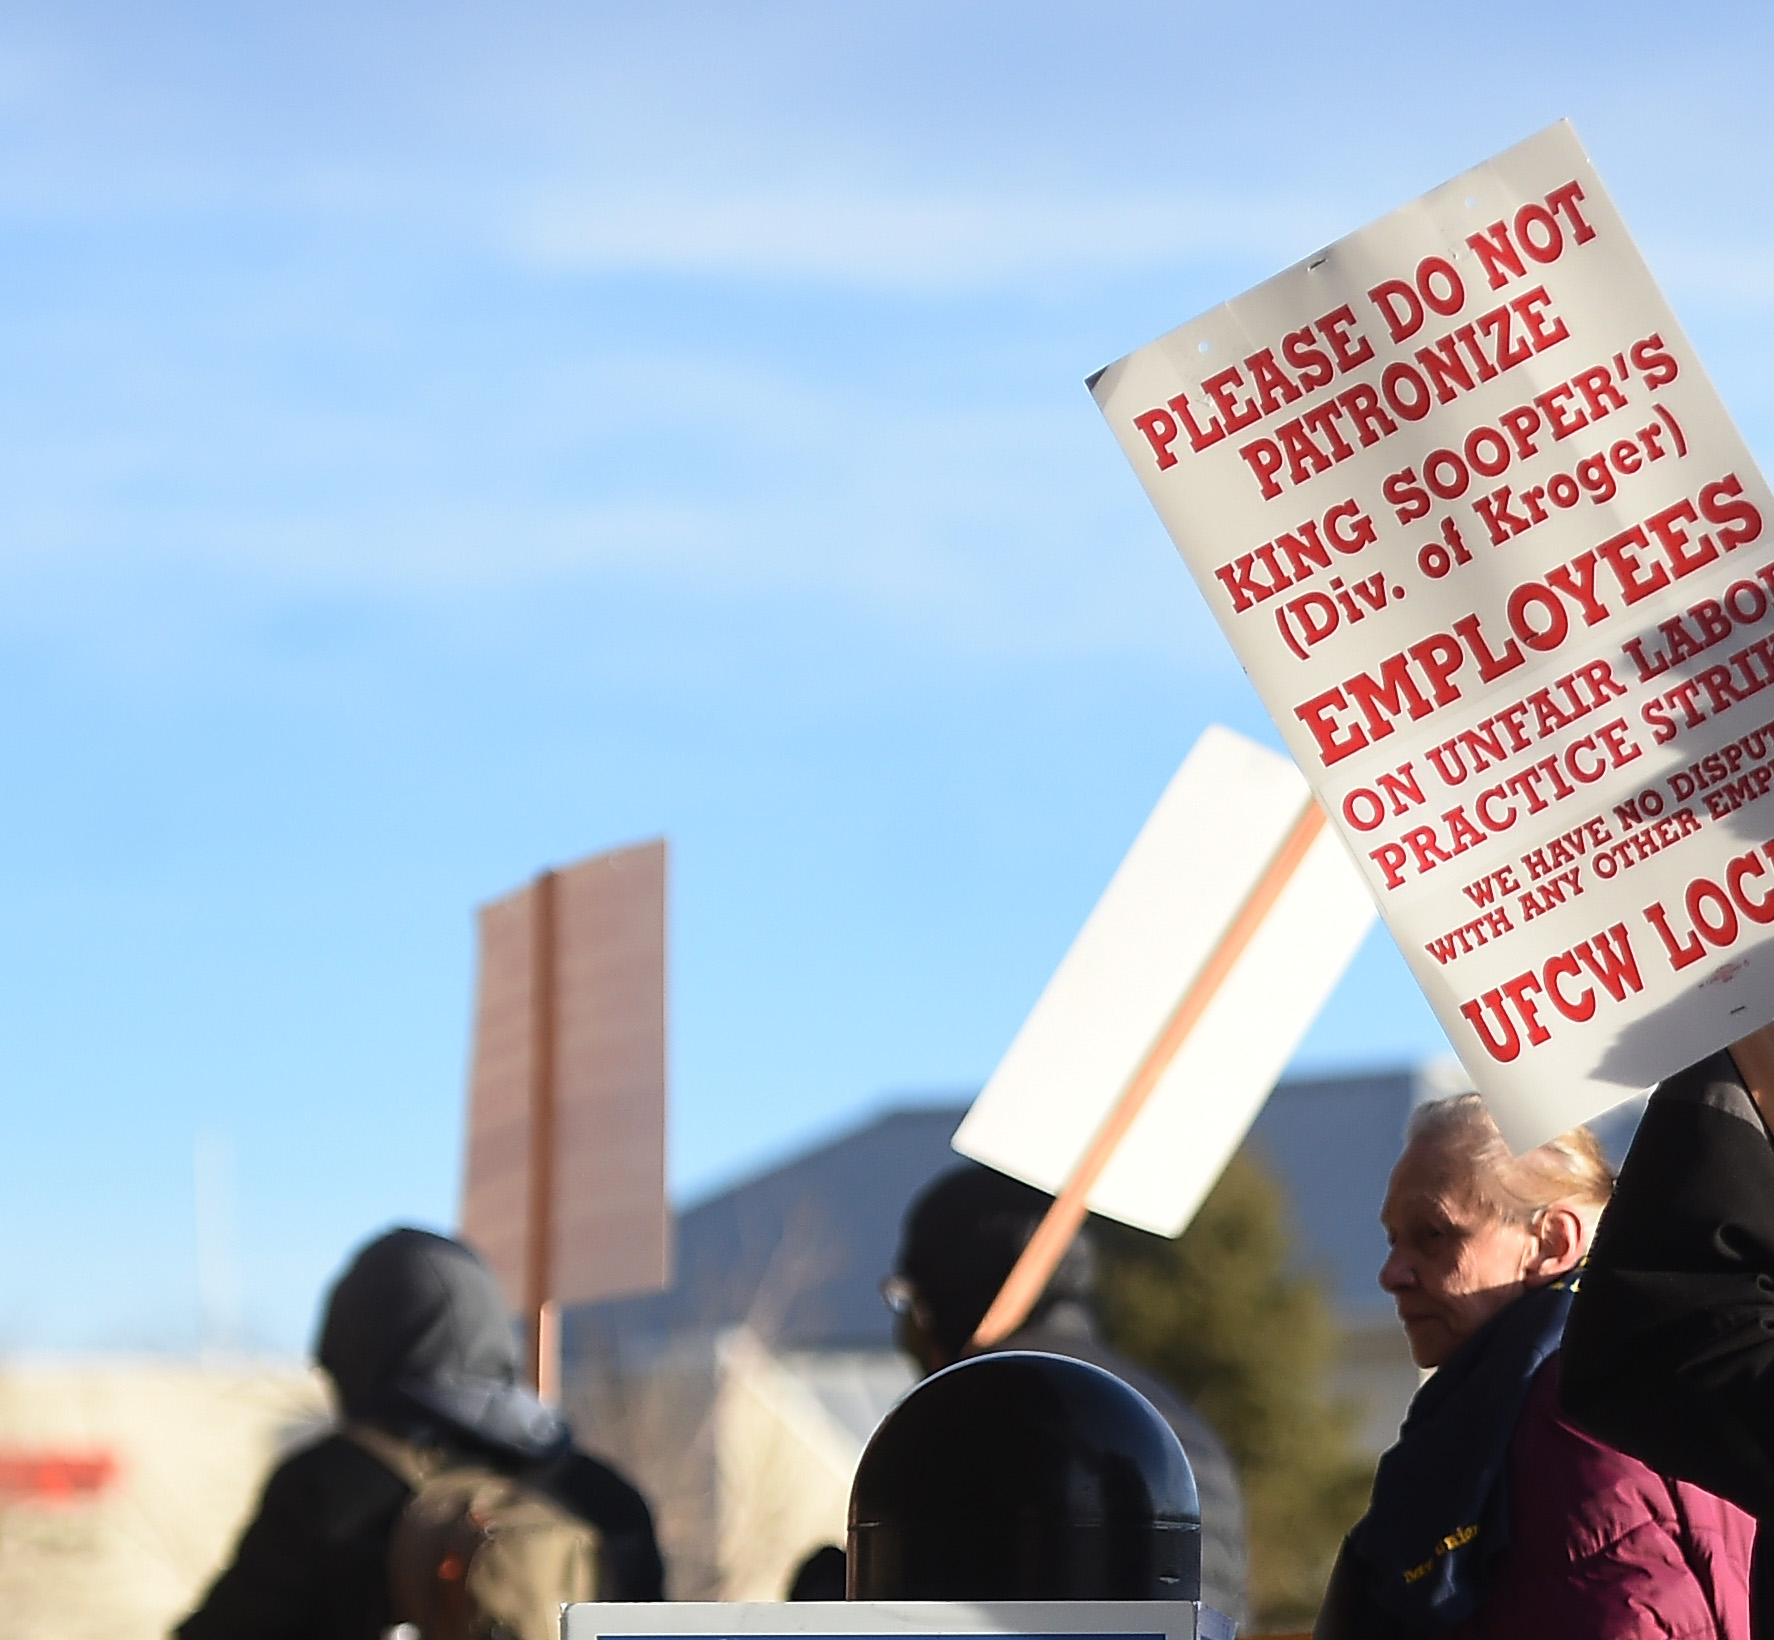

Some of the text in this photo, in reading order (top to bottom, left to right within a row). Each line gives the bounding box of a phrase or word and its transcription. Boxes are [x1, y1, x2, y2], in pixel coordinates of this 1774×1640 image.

[1133, 180, 1598, 472] PLEASE DO NOT
[1239, 285, 1571, 501] PATRONIZE
[1215, 334, 1680, 614] KING SOOPER'S
[1275, 404, 1688, 661] (Div. of Kroger)
[1294, 473, 1764, 767] EMPLOYEES
[1342, 762, 1428, 833] ON
[1424, 658, 1628, 787] UNFAIR
[1369, 718, 1643, 891] PRACTICE
[1425, 905, 1515, 966] WITH
[1518, 865, 1585, 923] ANY
[1592, 808, 1702, 880] OTHER
[1462, 865, 1521, 908] WE
[1521, 815, 1613, 882] HAVE
[1614, 789, 1664, 832] NO
[1460, 922, 1644, 1063] UFCW
